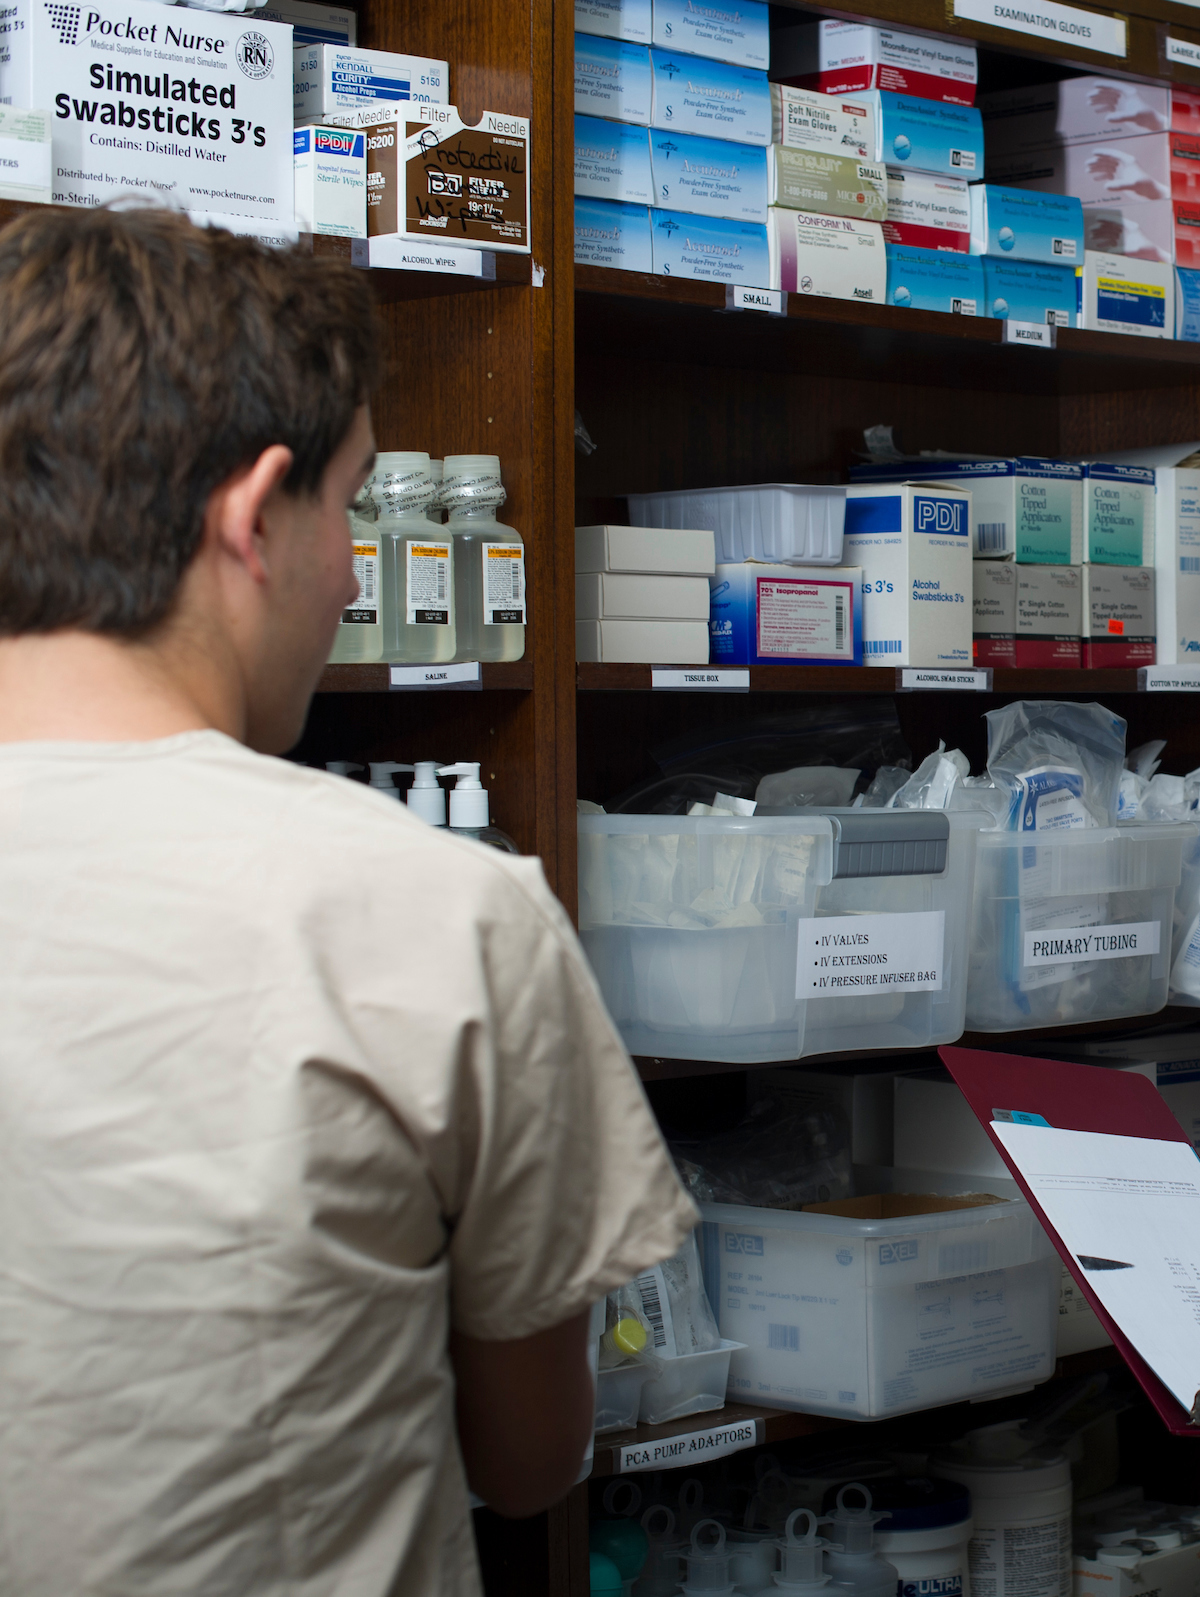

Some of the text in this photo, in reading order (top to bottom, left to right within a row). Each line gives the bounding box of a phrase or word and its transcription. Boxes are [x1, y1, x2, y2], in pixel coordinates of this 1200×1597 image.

[86, 12, 158, 43] Pocket
[994, 5, 1092, 38] EXAMINATION GLOVES
[90, 39, 228, 70] Medical Supplies for Education and Simulation
[244, 46, 266, 67] RN
[841, 55, 865, 65] MEDIUM
[920, 48, 936, 60] Vinyl
[937, 51, 954, 62] Exam
[955, 56, 975, 67] Gloves
[301, 60, 318, 71] 5150
[336, 61, 374, 74] KENDALL
[420, 75, 440, 87] 5150
[952, 70, 974, 81] MEDIUM
[90, 63, 236, 109] Simulated
[335, 83, 377, 97] Alcohol Preps
[685, 81, 743, 102] Accutouch
[683, 98, 747, 116] Powder-Free Synthetic
[788, 104, 830, 120] Soft Nitrile
[55, 93, 221, 140] Swabsticks
[231, 118, 266, 147] 3's
[357, 107, 391, 125] Needle
[420, 106, 526, 136] Filter Needle
[695, 110, 734, 123] Exam Gloves
[788, 114, 837, 132] Exam Gloves
[90, 133, 227, 163] Contains: Distilled Water
[318, 132, 349, 153] PDI
[317, 163, 361, 176] hospital formula
[681, 160, 738, 179] Accutouch
[859, 167, 883, 181] SMALL
[57, 168, 103, 182] Distributed
[105, 173, 118, 185] by:
[120, 176, 147, 188] Pocket
[317, 173, 364, 188] Sterile Wipes
[469, 176, 505, 188] FILTER
[679, 177, 742, 193] Powder-Free Synthetic
[189, 186, 275, 204] www.pocketnurse.com
[691, 189, 729, 200] Exam Gloves
[915, 202, 968, 217] Vinyl Exam Gloves
[798, 214, 855, 232] CONFORM NL
[946, 221, 968, 230] MEDIUM
[683, 238, 740, 257] Accutouch
[858, 237, 875, 247] Small
[402, 256, 456, 267] ALCOHOL WIPES
[681, 256, 744, 271] Powder-Free Synthetic
[693, 266, 732, 278] Exam Gloves
[853, 287, 873, 297] Ansell
[743, 293, 771, 306] SMALL
[1016, 329, 1043, 341] MEDIUM
[1021, 484, 1046, 496] Cotton
[1094, 487, 1119, 499] Cotton
[1021, 497, 1046, 511] Tipped
[1094, 499, 1120, 514] Tipped
[918, 500, 960, 532] PDI
[1021, 511, 1062, 524] Applicators
[1094, 513, 1134, 526] Applicators
[875, 580, 894, 593] 3's
[912, 579, 940, 590] Alcohol
[777, 588, 819, 596] Isopropanol
[912, 591, 965, 603] Swabsticks 3's
[1028, 600, 1046, 609] Single
[1101, 603, 1118, 612] Single
[975, 608, 1004, 617] Applicators
[1019, 609, 1069, 618] Tipped Applicators
[1092, 612, 1142, 621] Tipped Applicators
[425, 672, 447, 680] SALINE
[684, 674, 719, 682] TISSUE BOX
[916, 674, 975, 683] ALCOHOL SWAB STICKS
[1150, 680, 1171, 688] COTTON
[821, 933, 869, 947] IV VALVES
[1033, 934, 1137, 957] PRIMARY TUBING
[820, 954, 888, 967] IV EXTENSIONS
[819, 970, 937, 988] IV PRESSURE INFUSER BAG
[726, 1233, 763, 1255] EXEL
[880, 1241, 918, 1263] EXEL
[728, 1272, 743, 1280] REF
[728, 1285, 749, 1294] MODEL
[625, 1427, 752, 1467] PCA PUMP ADAPTORS
[919, 1577, 962, 1594] ULTRA
